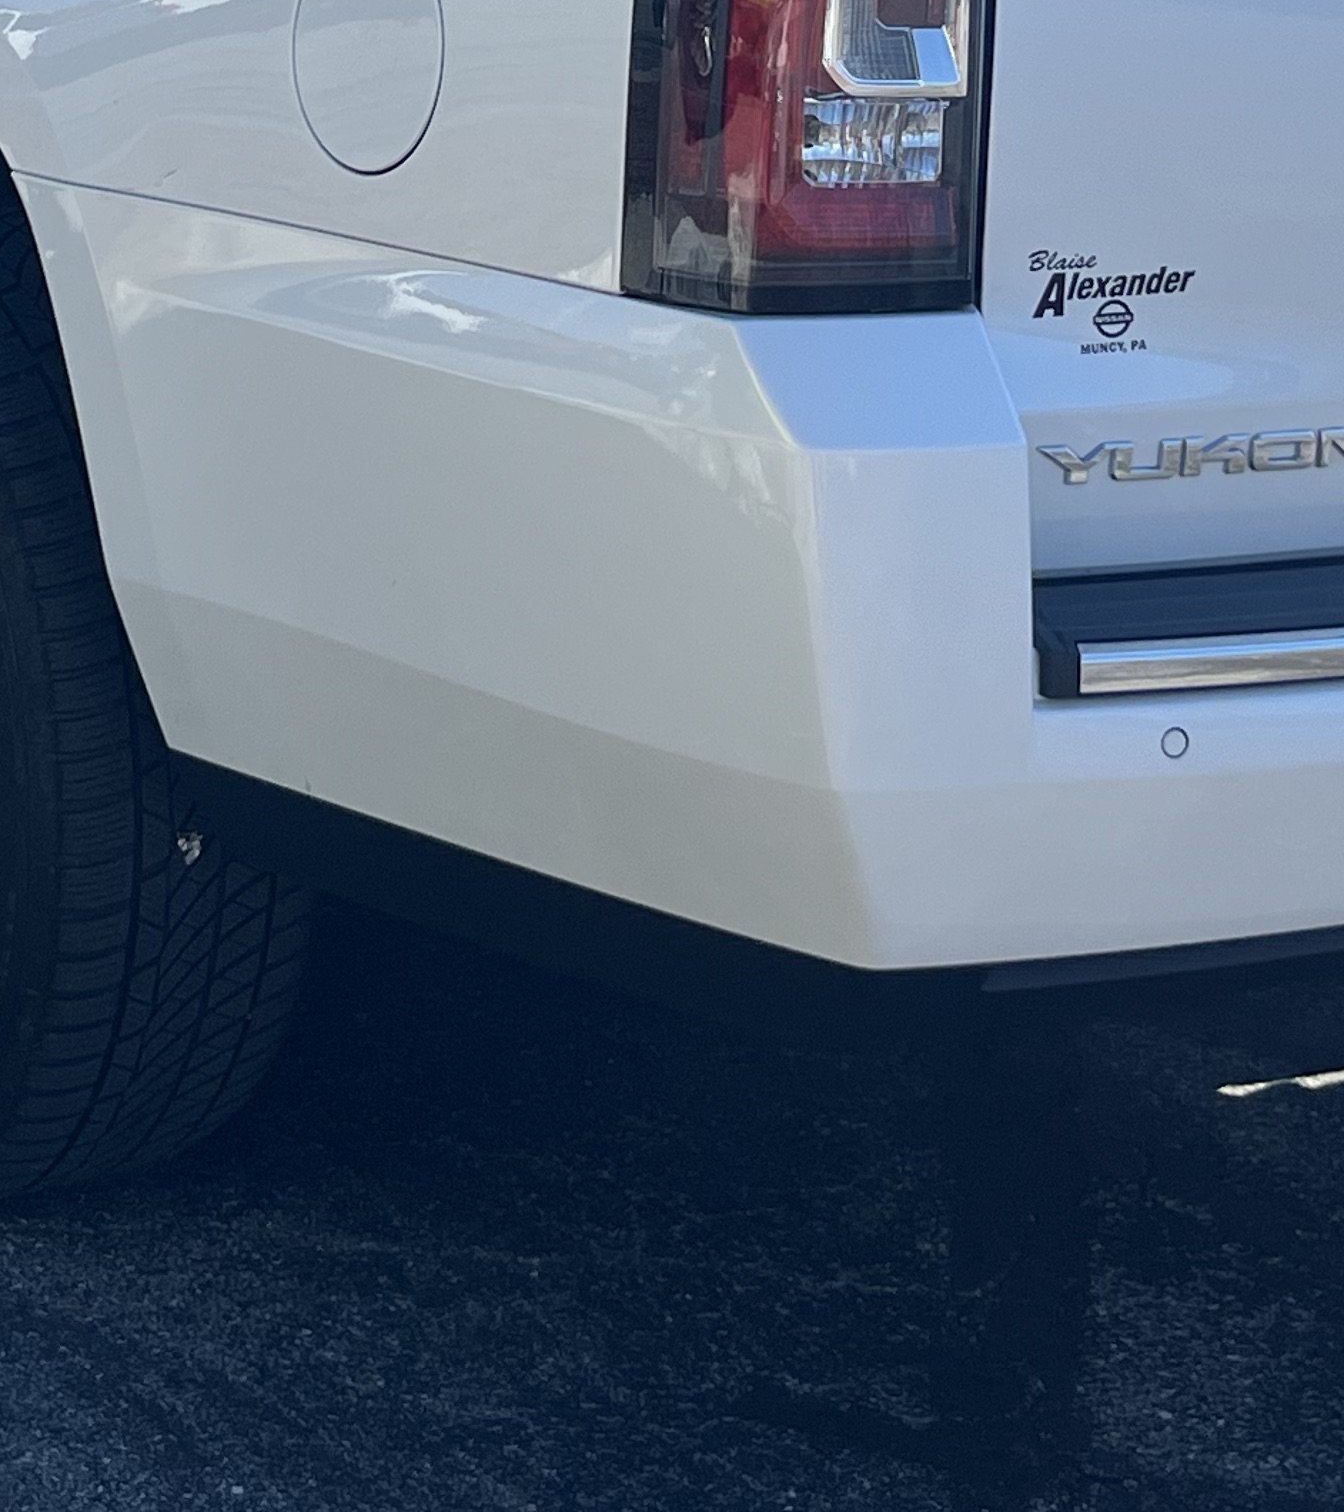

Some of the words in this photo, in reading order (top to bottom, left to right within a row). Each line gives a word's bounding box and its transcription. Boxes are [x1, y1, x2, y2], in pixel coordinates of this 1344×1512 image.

[1028, 250, 1097, 272] Blaise
[1032, 266, 1196, 318] Alexander
[1080, 341, 1128, 354] MUNCY,
[1131, 340, 1147, 351] PA
